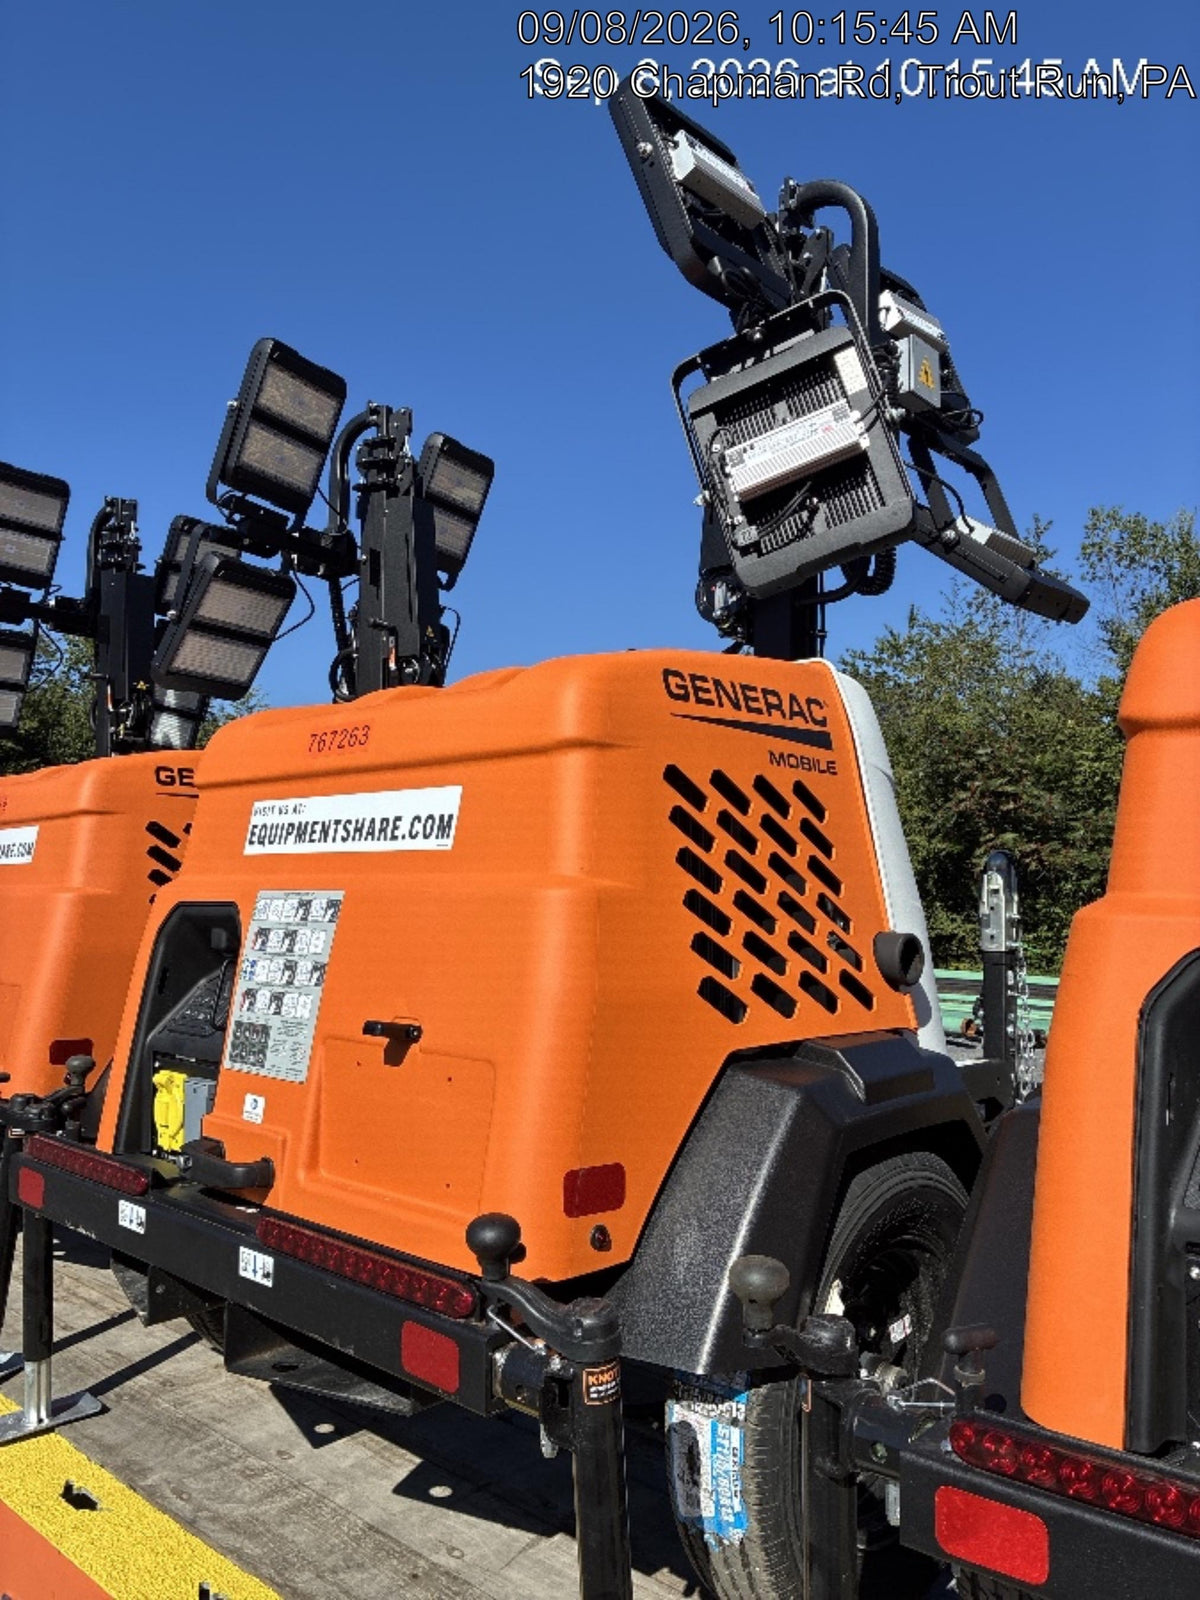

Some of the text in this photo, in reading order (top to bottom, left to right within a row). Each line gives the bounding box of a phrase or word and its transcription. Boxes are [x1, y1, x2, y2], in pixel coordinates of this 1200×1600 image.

[662, 667, 828, 728] GENERAC
[308, 724, 371, 753] 767263
[768, 749, 839, 776] MOBILE
[248, 813, 454, 848] EQUIPMENTSHARE.COM
